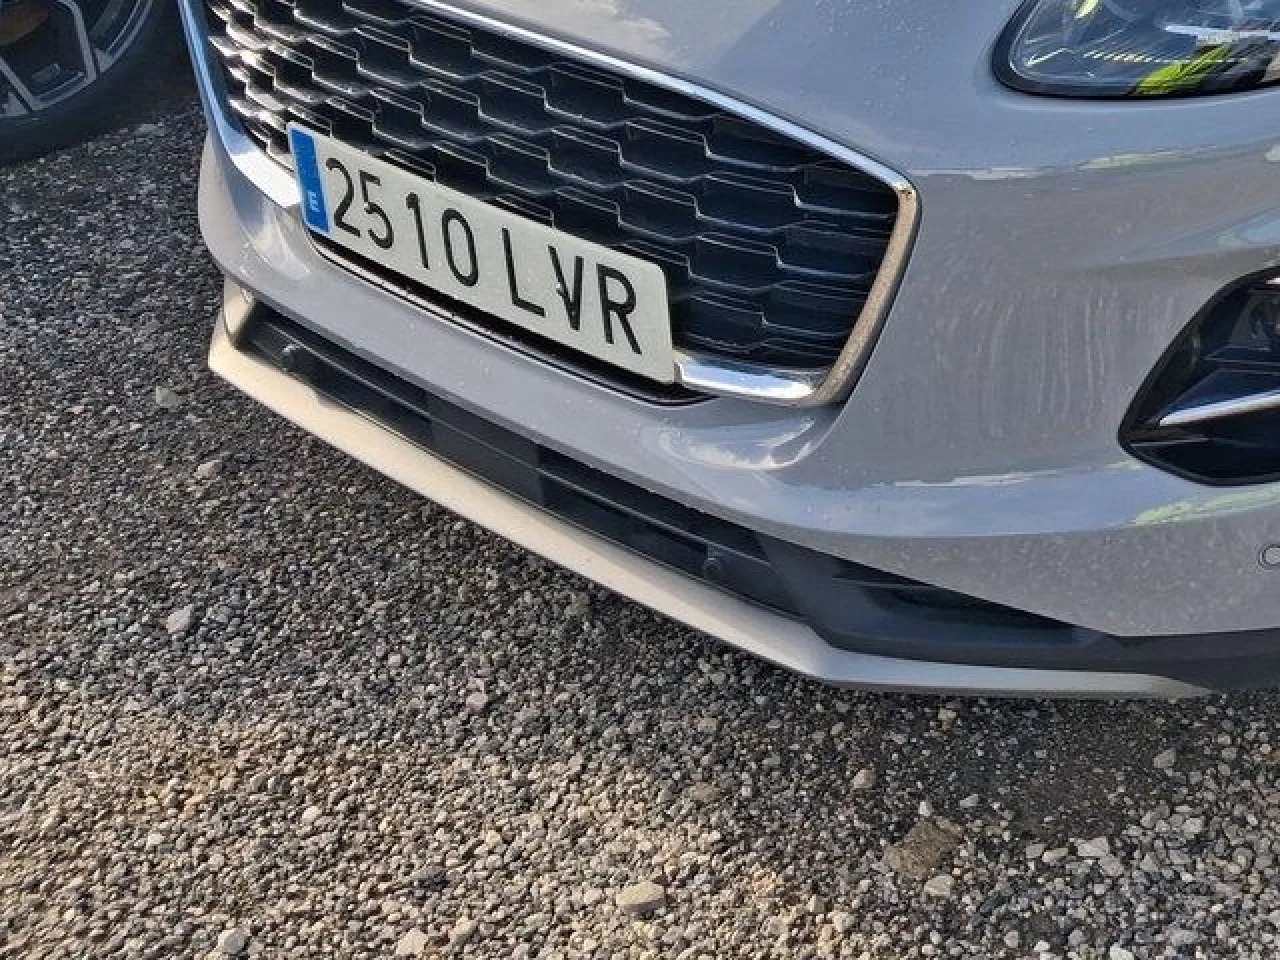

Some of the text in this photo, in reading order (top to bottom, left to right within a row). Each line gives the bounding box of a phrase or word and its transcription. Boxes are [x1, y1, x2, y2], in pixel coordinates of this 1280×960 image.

[306, 189, 319, 212] E
[325, 156, 643, 355] 2510 LVR
